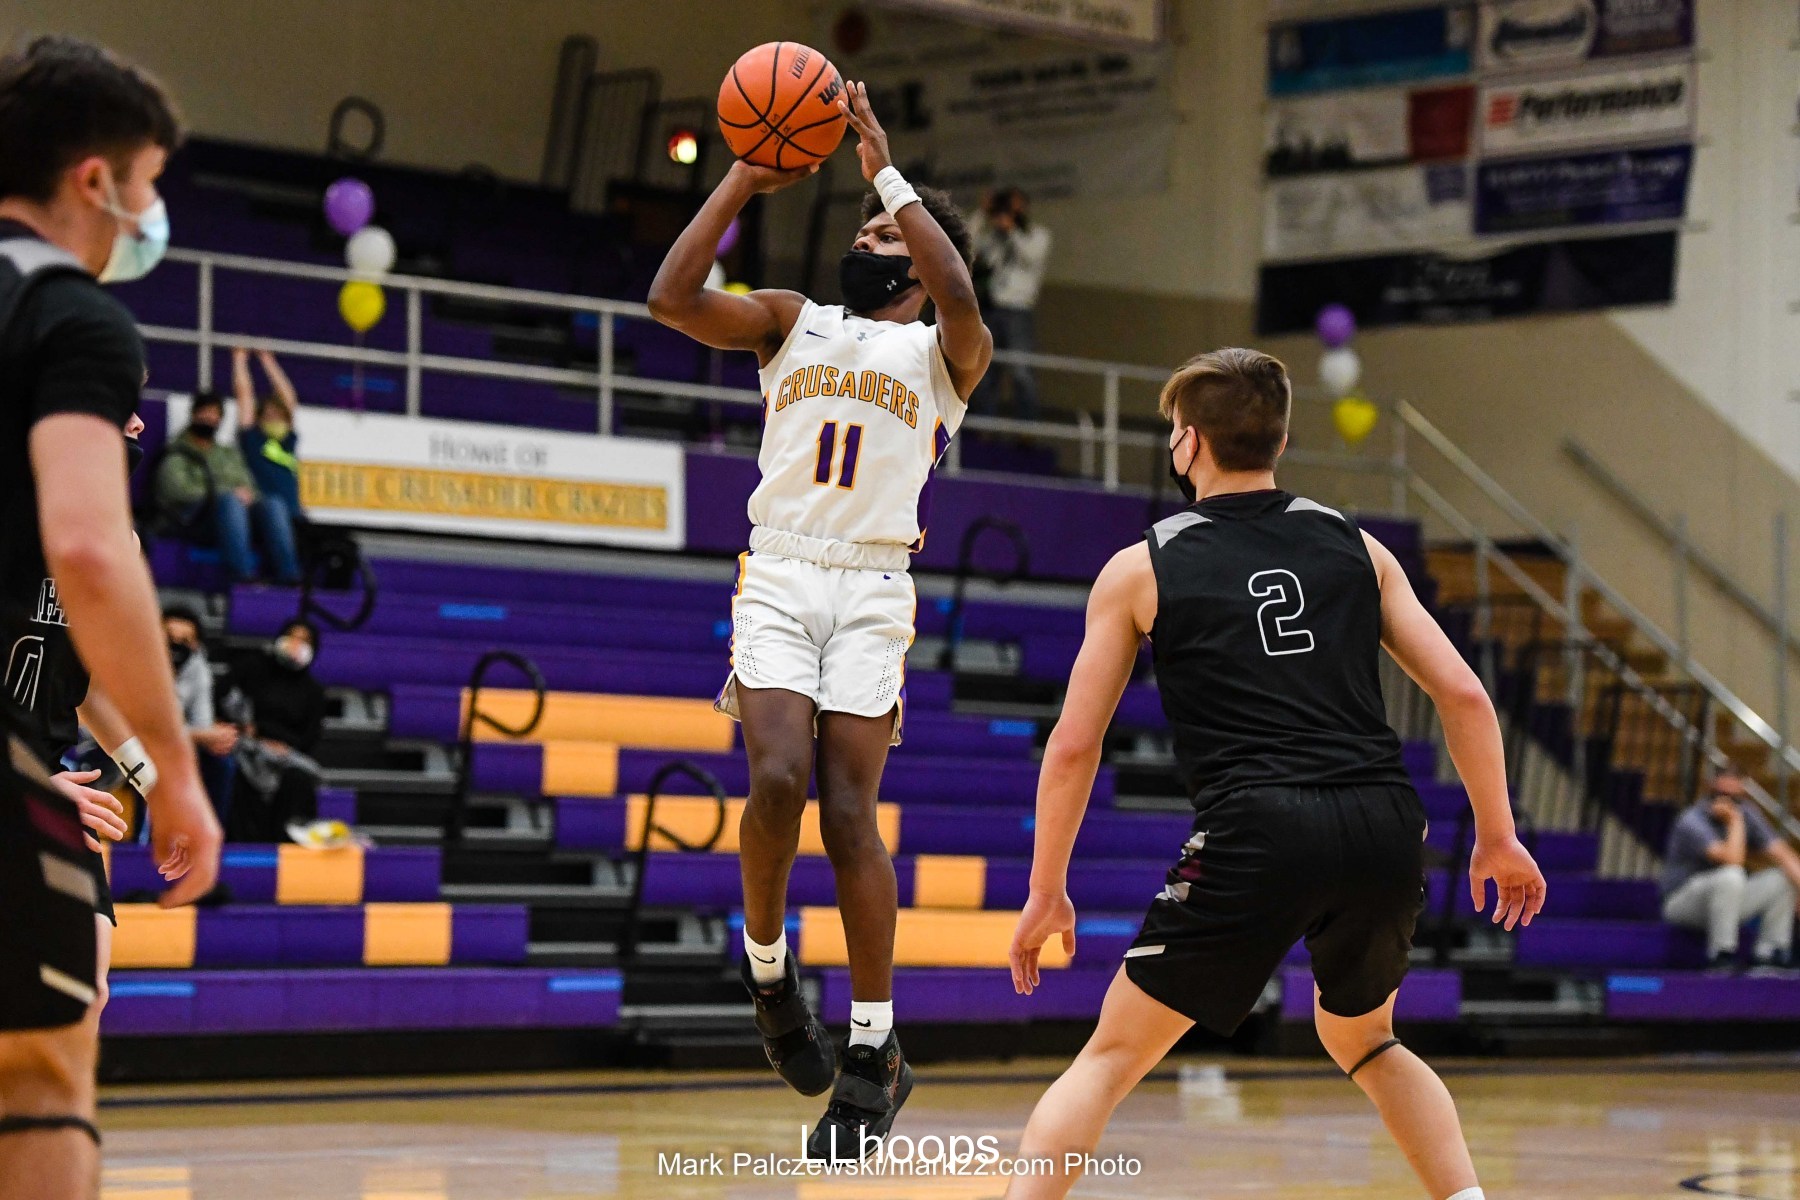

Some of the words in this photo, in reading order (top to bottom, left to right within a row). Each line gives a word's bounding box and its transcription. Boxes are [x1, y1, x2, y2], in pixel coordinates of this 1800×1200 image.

[775, 364, 920, 430] CRUSADERS
[428, 434, 508, 465] HOME
[813, 419, 865, 491] 11
[1247, 568, 1315, 656] 2
